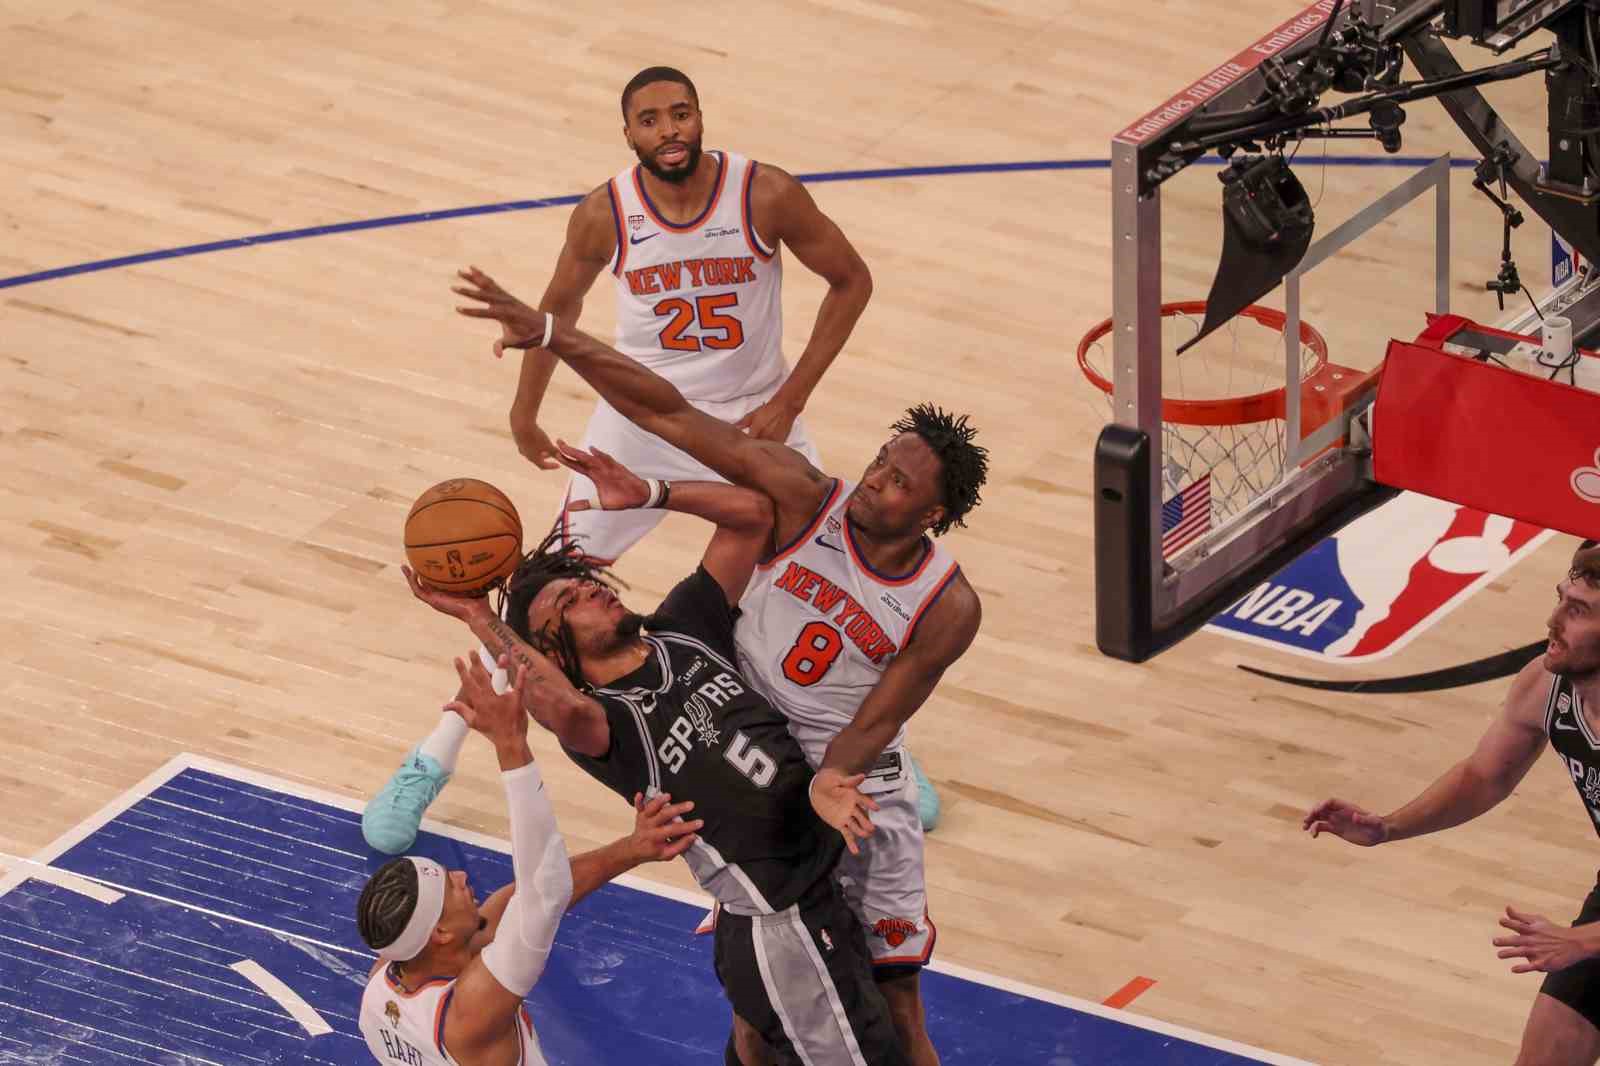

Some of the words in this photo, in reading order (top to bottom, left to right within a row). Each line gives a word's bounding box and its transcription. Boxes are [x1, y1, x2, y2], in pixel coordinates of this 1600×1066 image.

[1252, 13, 1323, 55] Emirates
[1123, 99, 1194, 139] Emirates
[625, 260, 681, 295] NEW
[683, 256, 757, 287] YORK
[653, 291, 745, 352] 25
[774, 560, 848, 614] NEW
[833, 595, 898, 665] YORK
[1221, 582, 1343, 637] NBA
[781, 620, 844, 687] 8
[722, 730, 778, 789] 5
